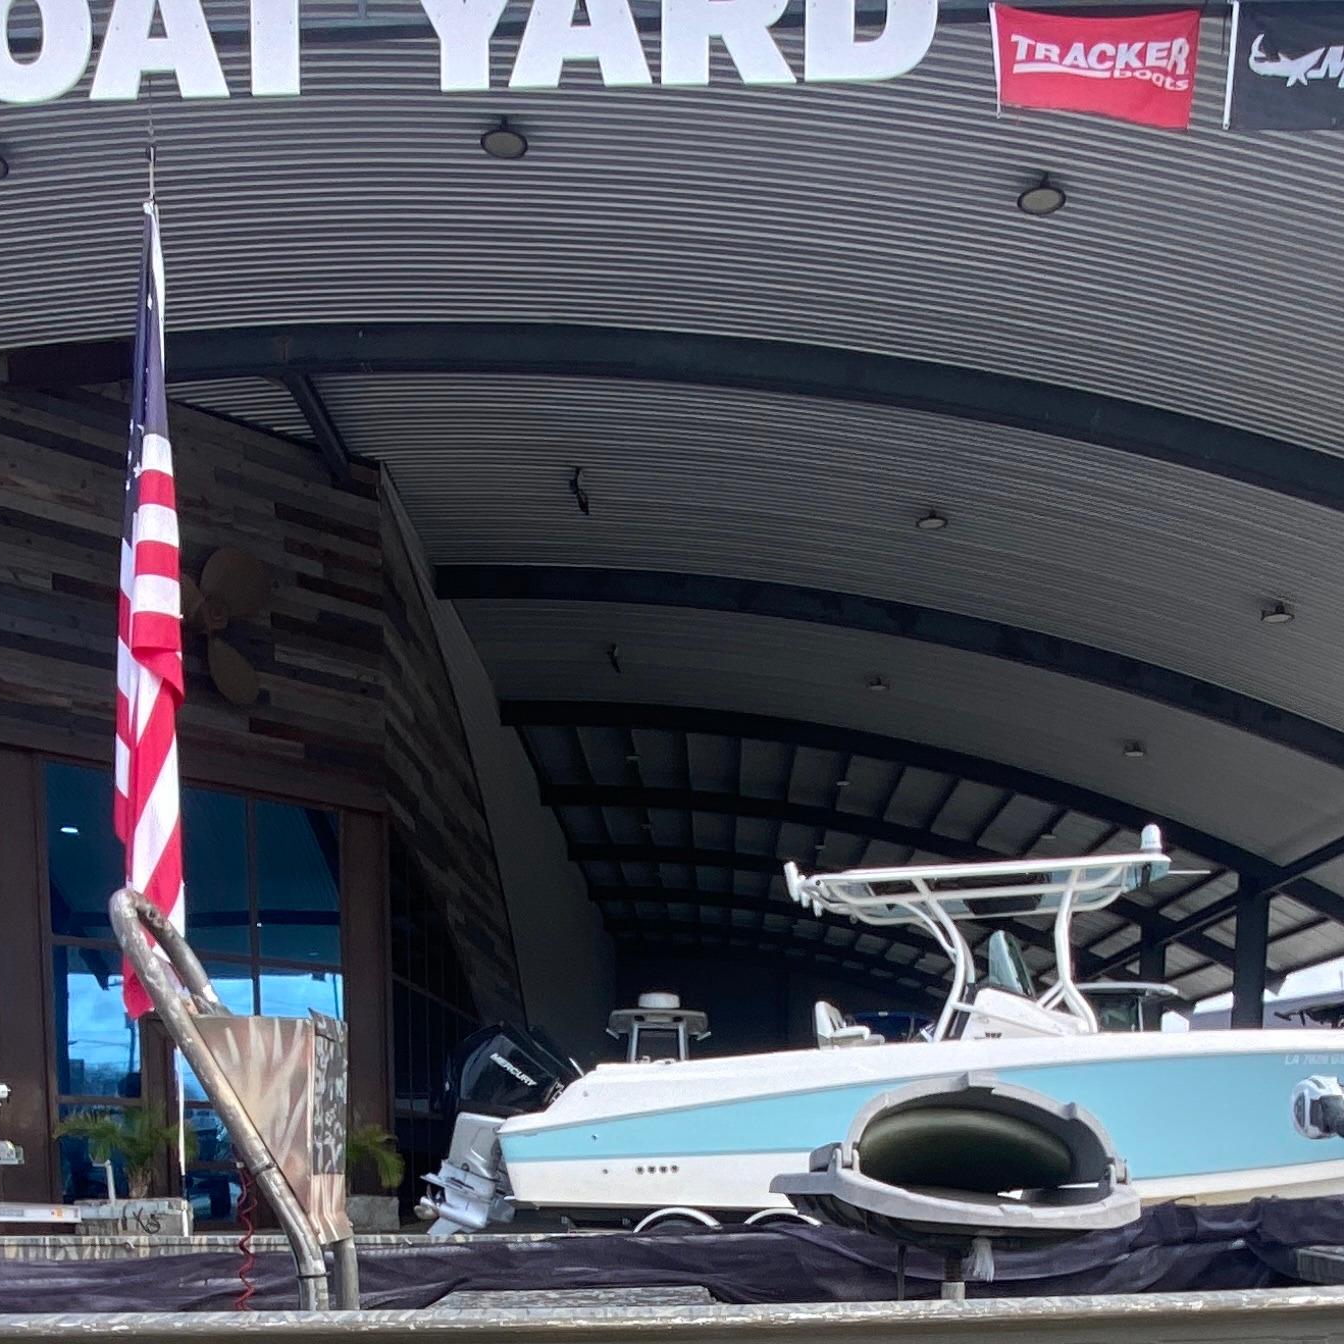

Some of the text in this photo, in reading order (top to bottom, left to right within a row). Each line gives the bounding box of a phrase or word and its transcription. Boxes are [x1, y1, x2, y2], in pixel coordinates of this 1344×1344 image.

[420, 0, 939, 93] YARD
[1010, 34, 1190, 76] TRACKER
[1113, 69, 1190, 91] boats
[489, 1052, 538, 1087] MERCURY
